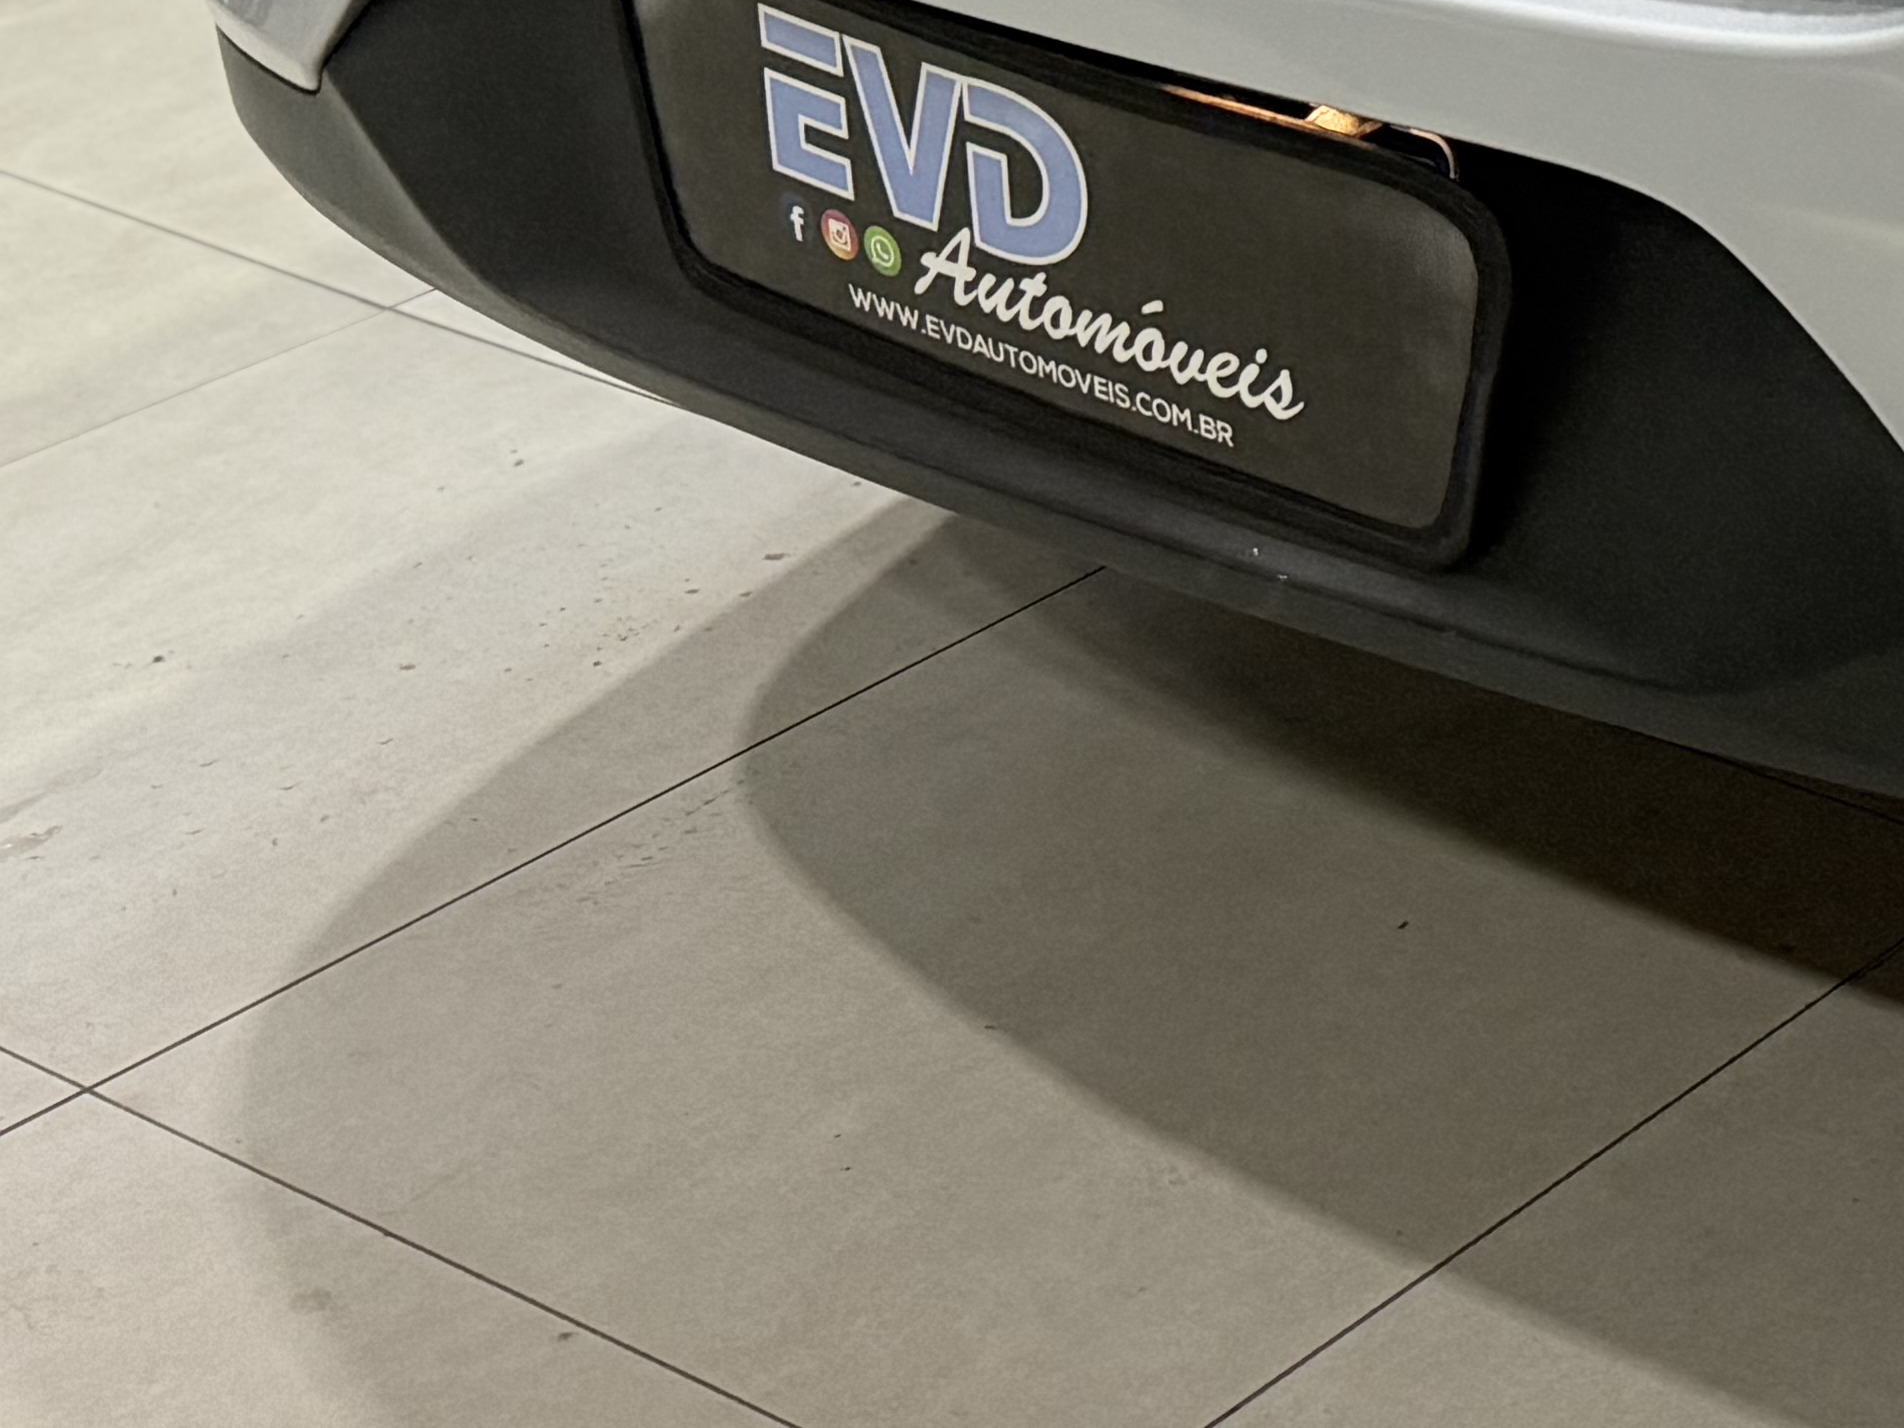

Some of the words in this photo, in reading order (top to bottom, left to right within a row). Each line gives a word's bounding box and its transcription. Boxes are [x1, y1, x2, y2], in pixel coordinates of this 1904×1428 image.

[757, 2, 1088, 265] EVD
[848, 282, 1235, 449] WWW.EVDAUTOMOVEIS.COM.BR
[914, 227, 1305, 421] Automóveis
